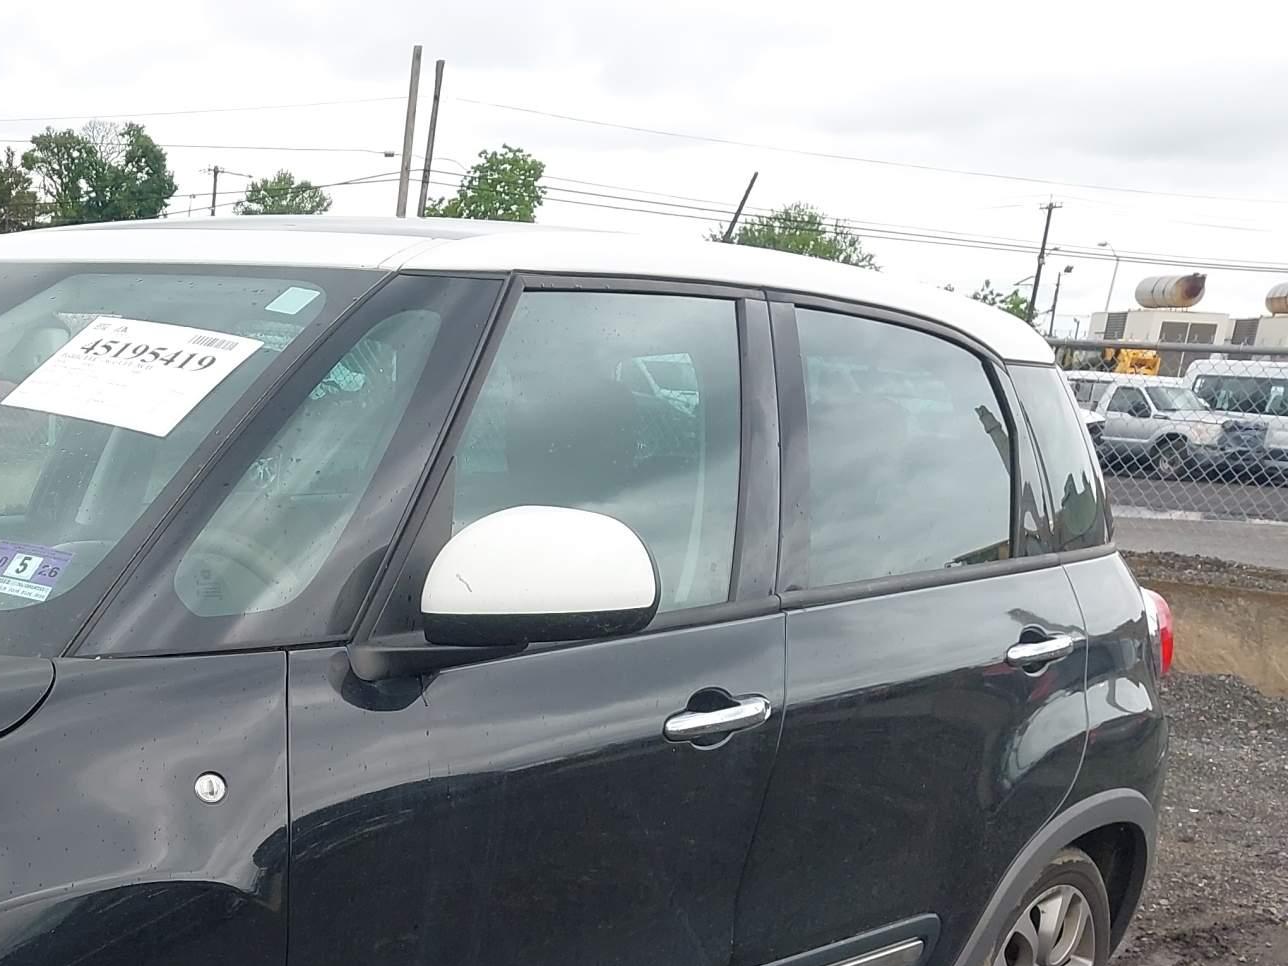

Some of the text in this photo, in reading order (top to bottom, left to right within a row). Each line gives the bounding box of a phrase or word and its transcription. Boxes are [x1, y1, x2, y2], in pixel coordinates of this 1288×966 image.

[80, 338, 217, 372] 45195419
[15, 556, 33, 574] 5
[38, 564, 60, 578] 26
